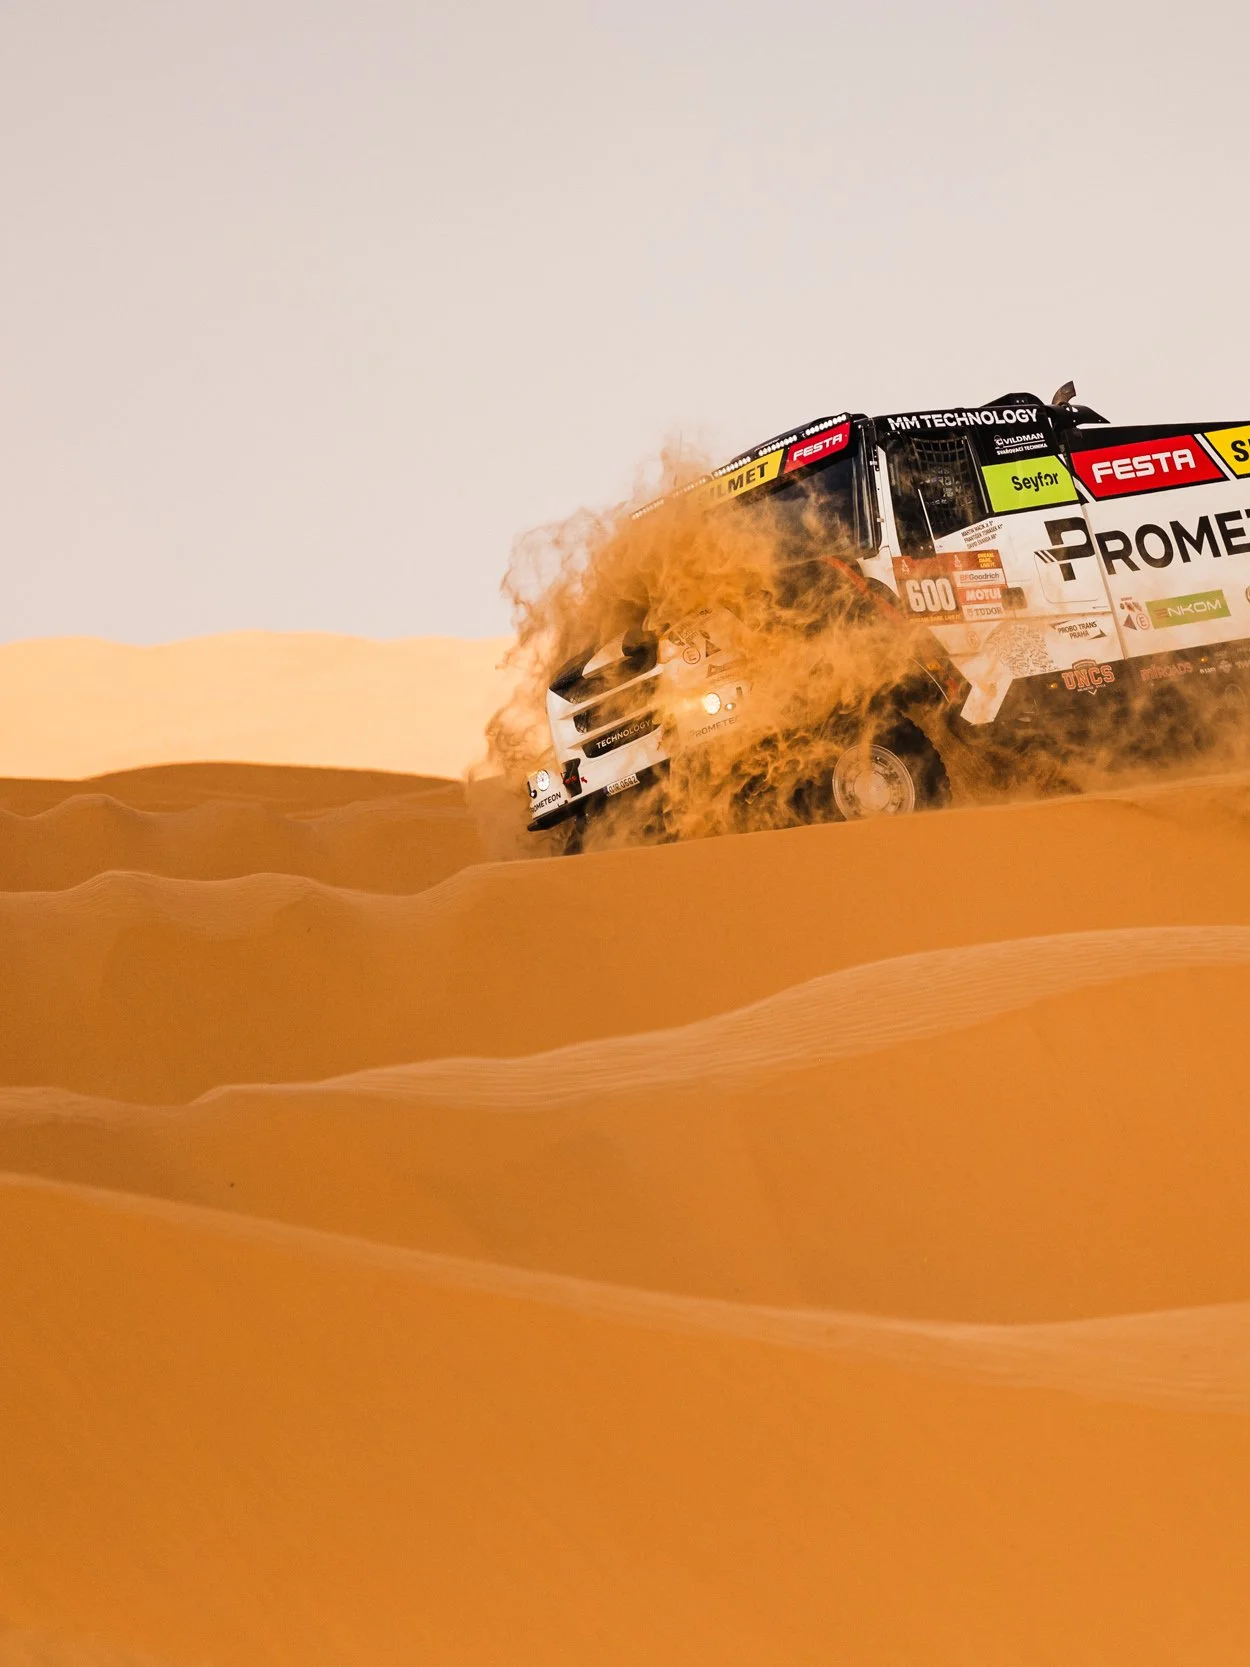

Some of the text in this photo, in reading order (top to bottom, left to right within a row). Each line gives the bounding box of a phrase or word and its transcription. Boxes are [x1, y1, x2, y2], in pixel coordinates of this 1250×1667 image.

[887, 408, 1037, 431] MM TECHNOLOGY
[792, 433, 842, 461] FESTA
[1091, 448, 1196, 484] FESTA
[1011, 471, 1059, 494] Seyfor
[960, 573, 1000, 581] BFGoodrich
[905, 577, 956, 612] 600
[1057, 621, 1098, 634] PROBO TRANS
[1069, 630, 1089, 639] PRAHA
[1061, 665, 1115, 690] UNCS
[596, 719, 651, 749] TECHNOLOGY
